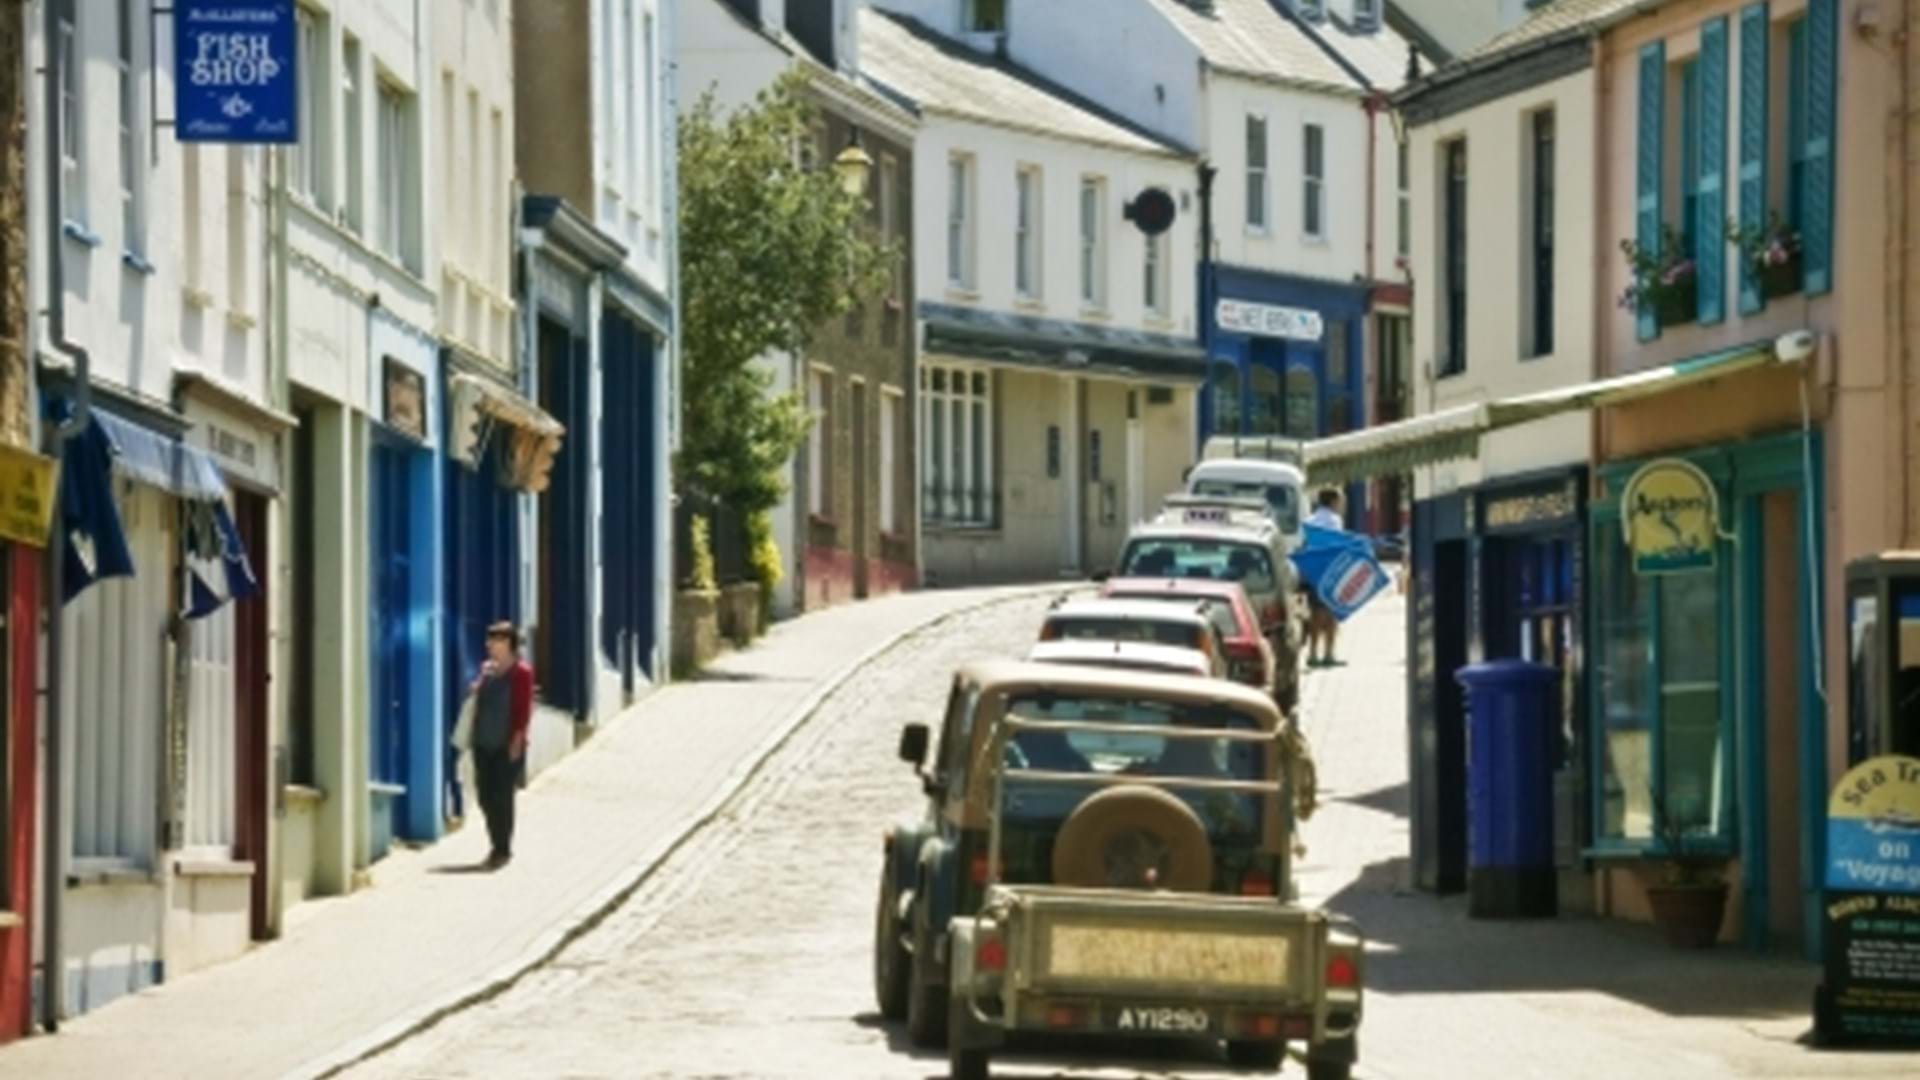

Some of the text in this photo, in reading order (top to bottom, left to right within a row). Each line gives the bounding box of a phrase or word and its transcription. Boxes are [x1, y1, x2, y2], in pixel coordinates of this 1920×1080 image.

[197, 32, 270, 60] FISH
[191, 59, 280, 86] SHOP
[1841, 768, 1887, 806] Sea
[1879, 842, 1910, 859] on
